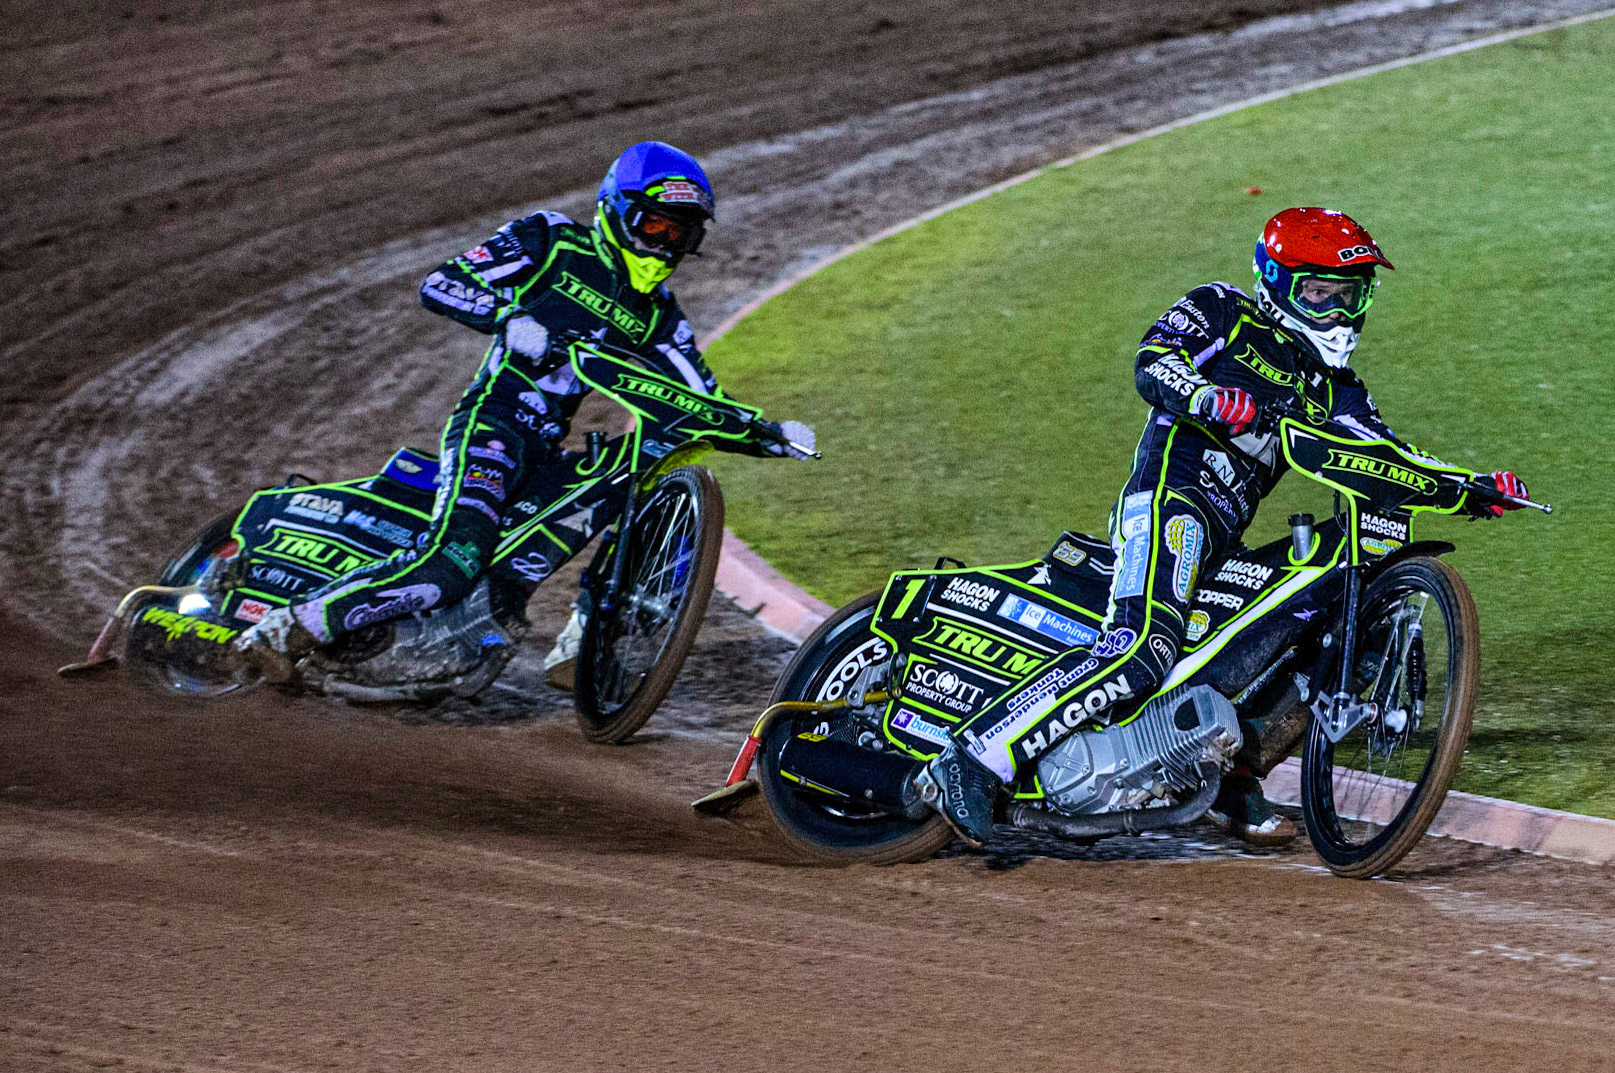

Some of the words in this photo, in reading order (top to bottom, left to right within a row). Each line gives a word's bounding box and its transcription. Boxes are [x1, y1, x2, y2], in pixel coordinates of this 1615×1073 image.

[566, 280, 612, 314] TRU
[1158, 310, 1210, 339] COTT
[1144, 362, 1195, 396] SHOCKS
[1250, 353, 1292, 384] TRU
[626, 379, 673, 399] TRU
[1333, 453, 1385, 474] TRU
[1387, 467, 1432, 490] MIX
[1132, 517, 1146, 534] Ice
[1360, 522, 1406, 540] SHOCKS
[1361, 512, 1407, 533] HAGON
[275, 536, 339, 564] TRU
[1126, 536, 1147, 591] Machines
[1178, 523, 1197, 592] AGROMIX
[251, 565, 305, 591] SCOTT
[1214, 571, 1265, 591] SHOCKS
[1221, 559, 1273, 582] HAGON
[891, 579, 926, 620] 1
[941, 589, 990, 612] SHOCKS
[947, 577, 1000, 603] HAGON
[1025, 605, 1042, 620] Ice
[1043, 611, 1093, 643] Machines
[934, 624, 1007, 662] TRU
[909, 664, 984, 705] SCOTT
[1059, 658, 1099, 688] Grant
[906, 682, 947, 703] PROPERTY
[944, 696, 973, 714] GROUP
[1006, 668, 1065, 711] Tankers
[985, 683, 1060, 740] Henderson
[1022, 674, 1132, 759] HAGON
